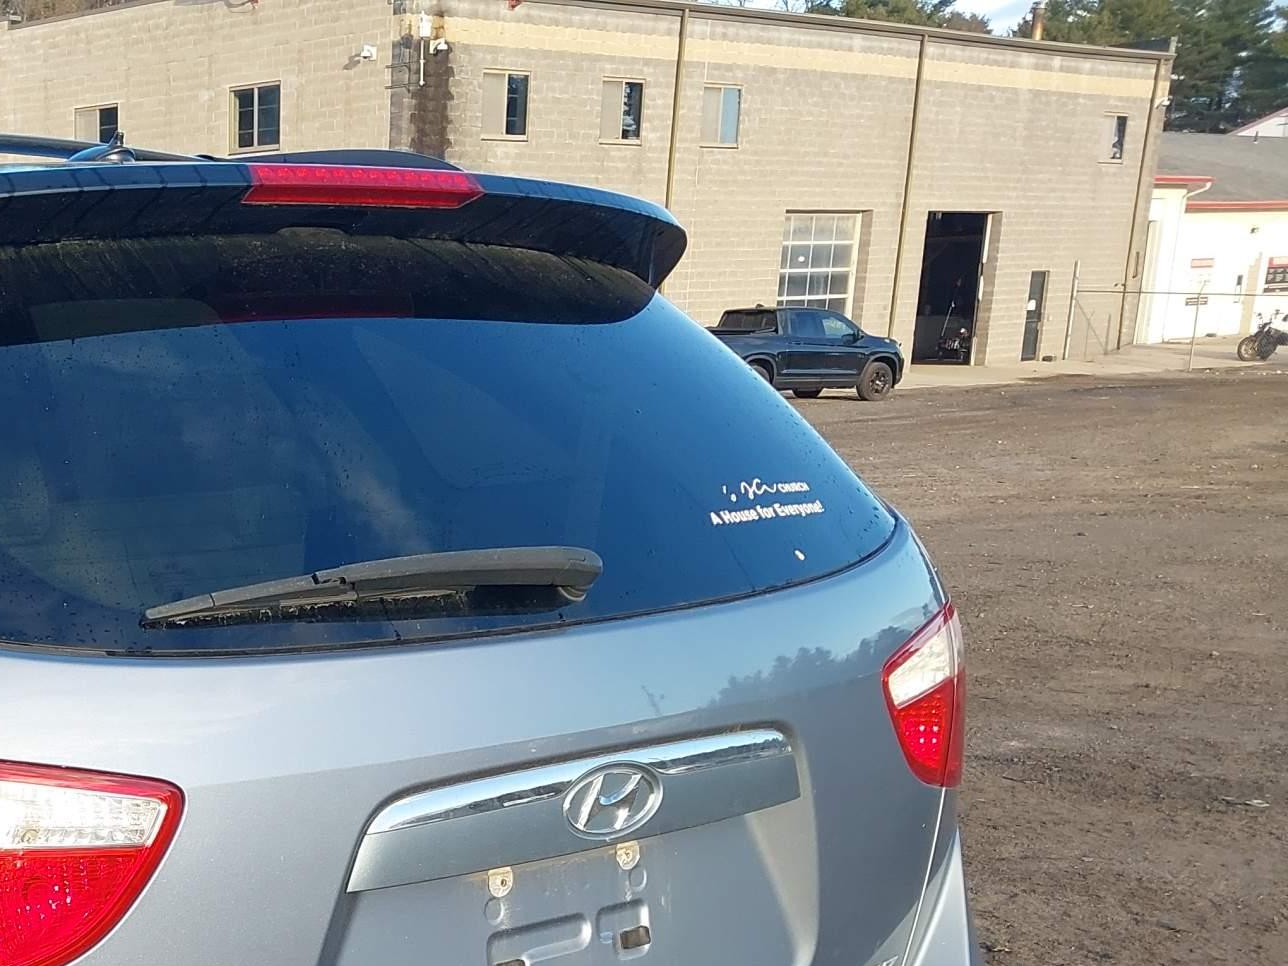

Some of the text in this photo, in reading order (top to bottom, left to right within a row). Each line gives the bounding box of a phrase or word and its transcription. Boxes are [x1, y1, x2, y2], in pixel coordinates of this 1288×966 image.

[710, 511, 723, 525] A
[720, 507, 759, 524] House
[756, 504, 776, 519] for
